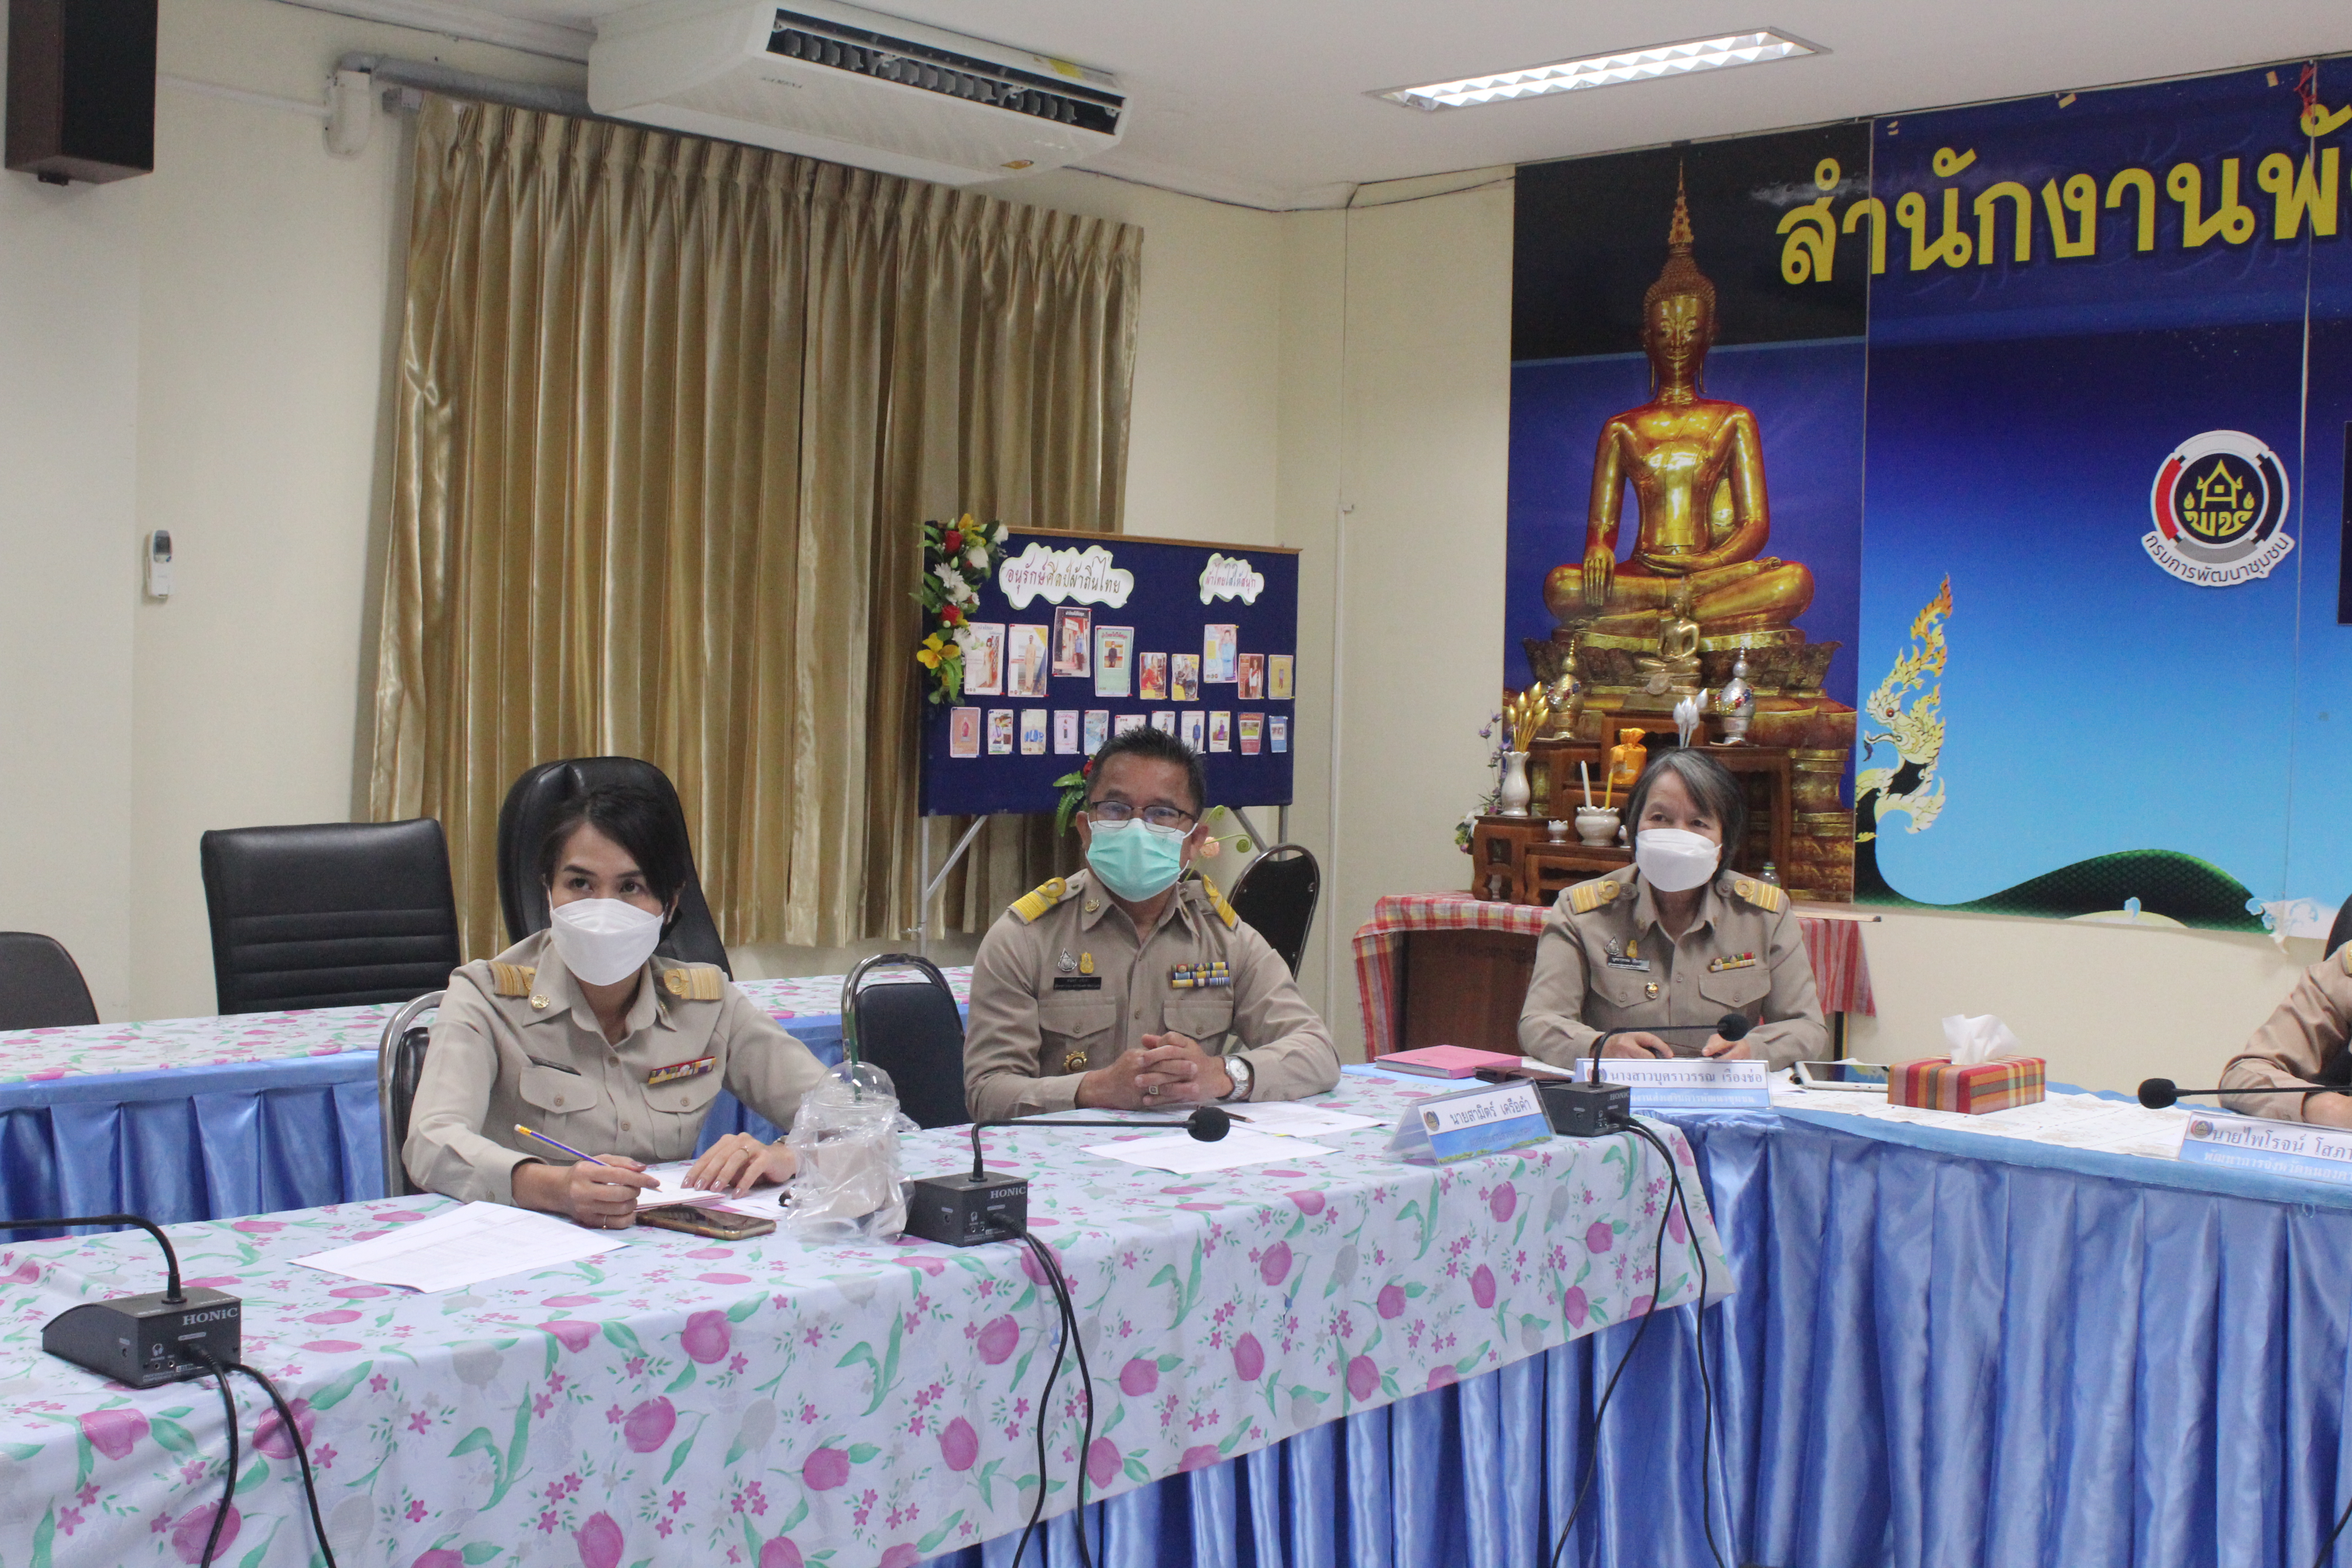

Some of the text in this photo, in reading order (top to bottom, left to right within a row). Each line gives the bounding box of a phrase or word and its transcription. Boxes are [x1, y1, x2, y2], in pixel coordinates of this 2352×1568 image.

[1776, 103, 2352, 285] สำนักงานพั
[2145, 534, 2289, 583] กรมการพัฒนาชุมชน
[1610, 1071, 1716, 1086] นางสาวบุศราวรรณ
[2212, 1126, 2306, 1153] นายไพโรจน์
